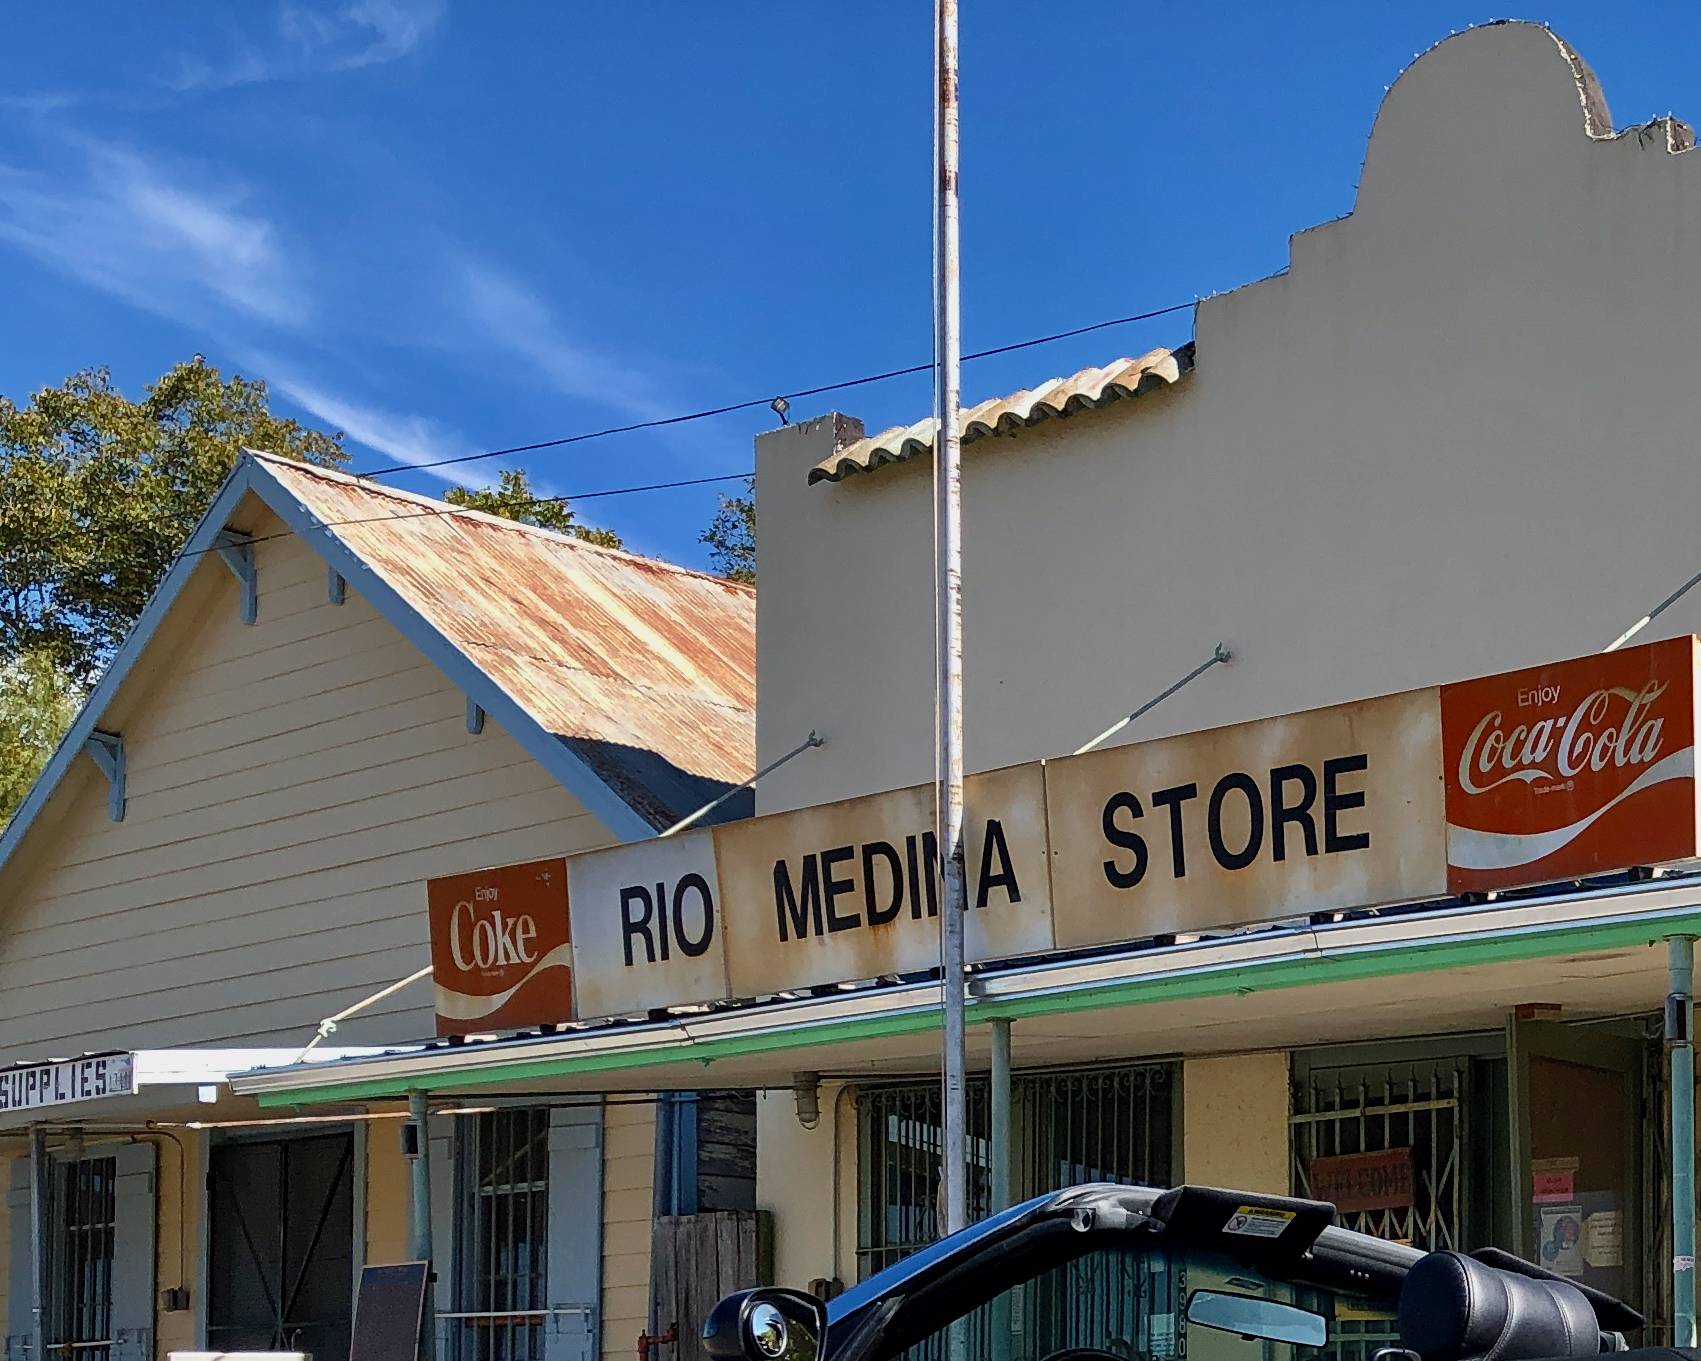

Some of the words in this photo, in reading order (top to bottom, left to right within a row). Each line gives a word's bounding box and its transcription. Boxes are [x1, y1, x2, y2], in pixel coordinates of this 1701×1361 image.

[1518, 684, 1561, 707] Enjoy
[1458, 679, 1670, 795] Coca-Cola
[475, 886, 499, 902] Enjoy
[619, 872, 714, 966] RIO
[773, 818, 1022, 942] MEDINA
[1102, 754, 1370, 889] STORE
[450, 900, 538, 971] Coke
[0, 1059, 107, 1109] SUPPLIES
[1179, 1271, 1187, 1356] 3980
